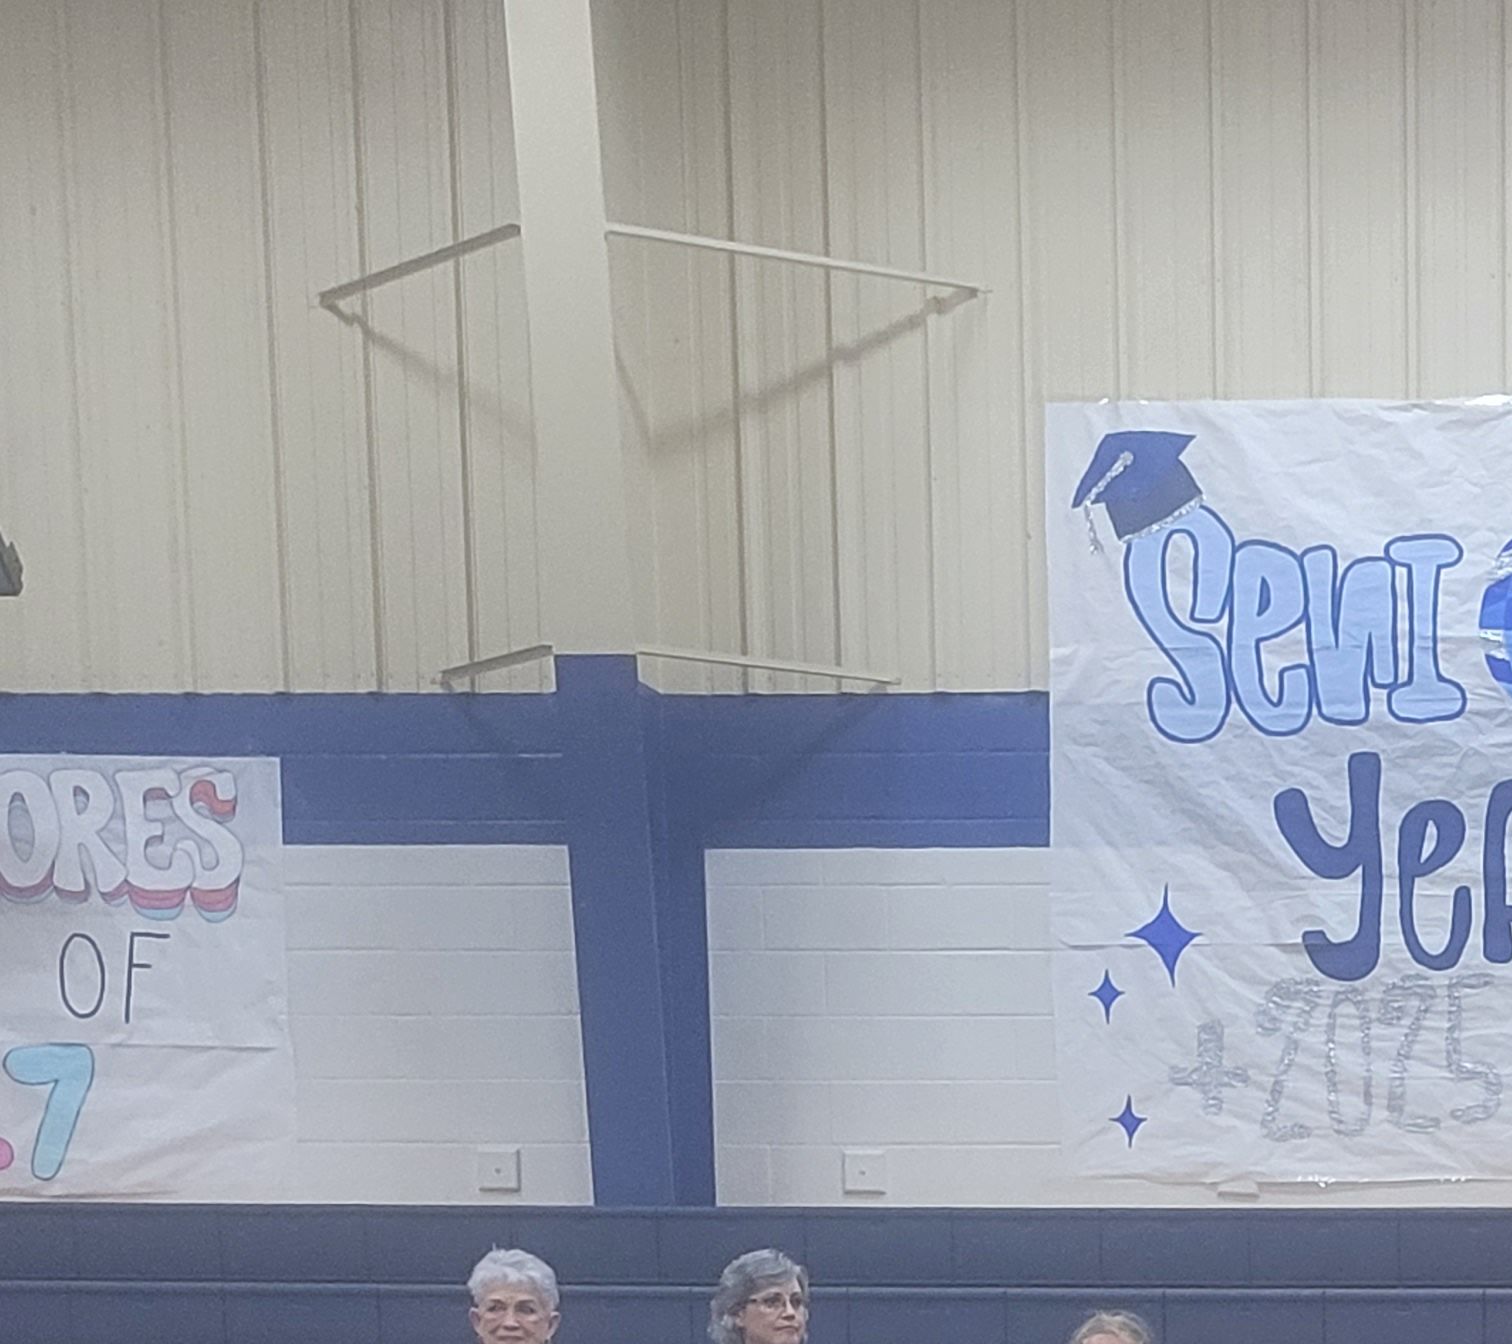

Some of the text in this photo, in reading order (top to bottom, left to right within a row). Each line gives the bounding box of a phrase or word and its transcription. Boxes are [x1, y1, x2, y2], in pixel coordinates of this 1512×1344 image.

[0, 766, 245, 922] ORES
[59, 931, 171, 1024] OF
[0, 1042, 95, 1181] 7
